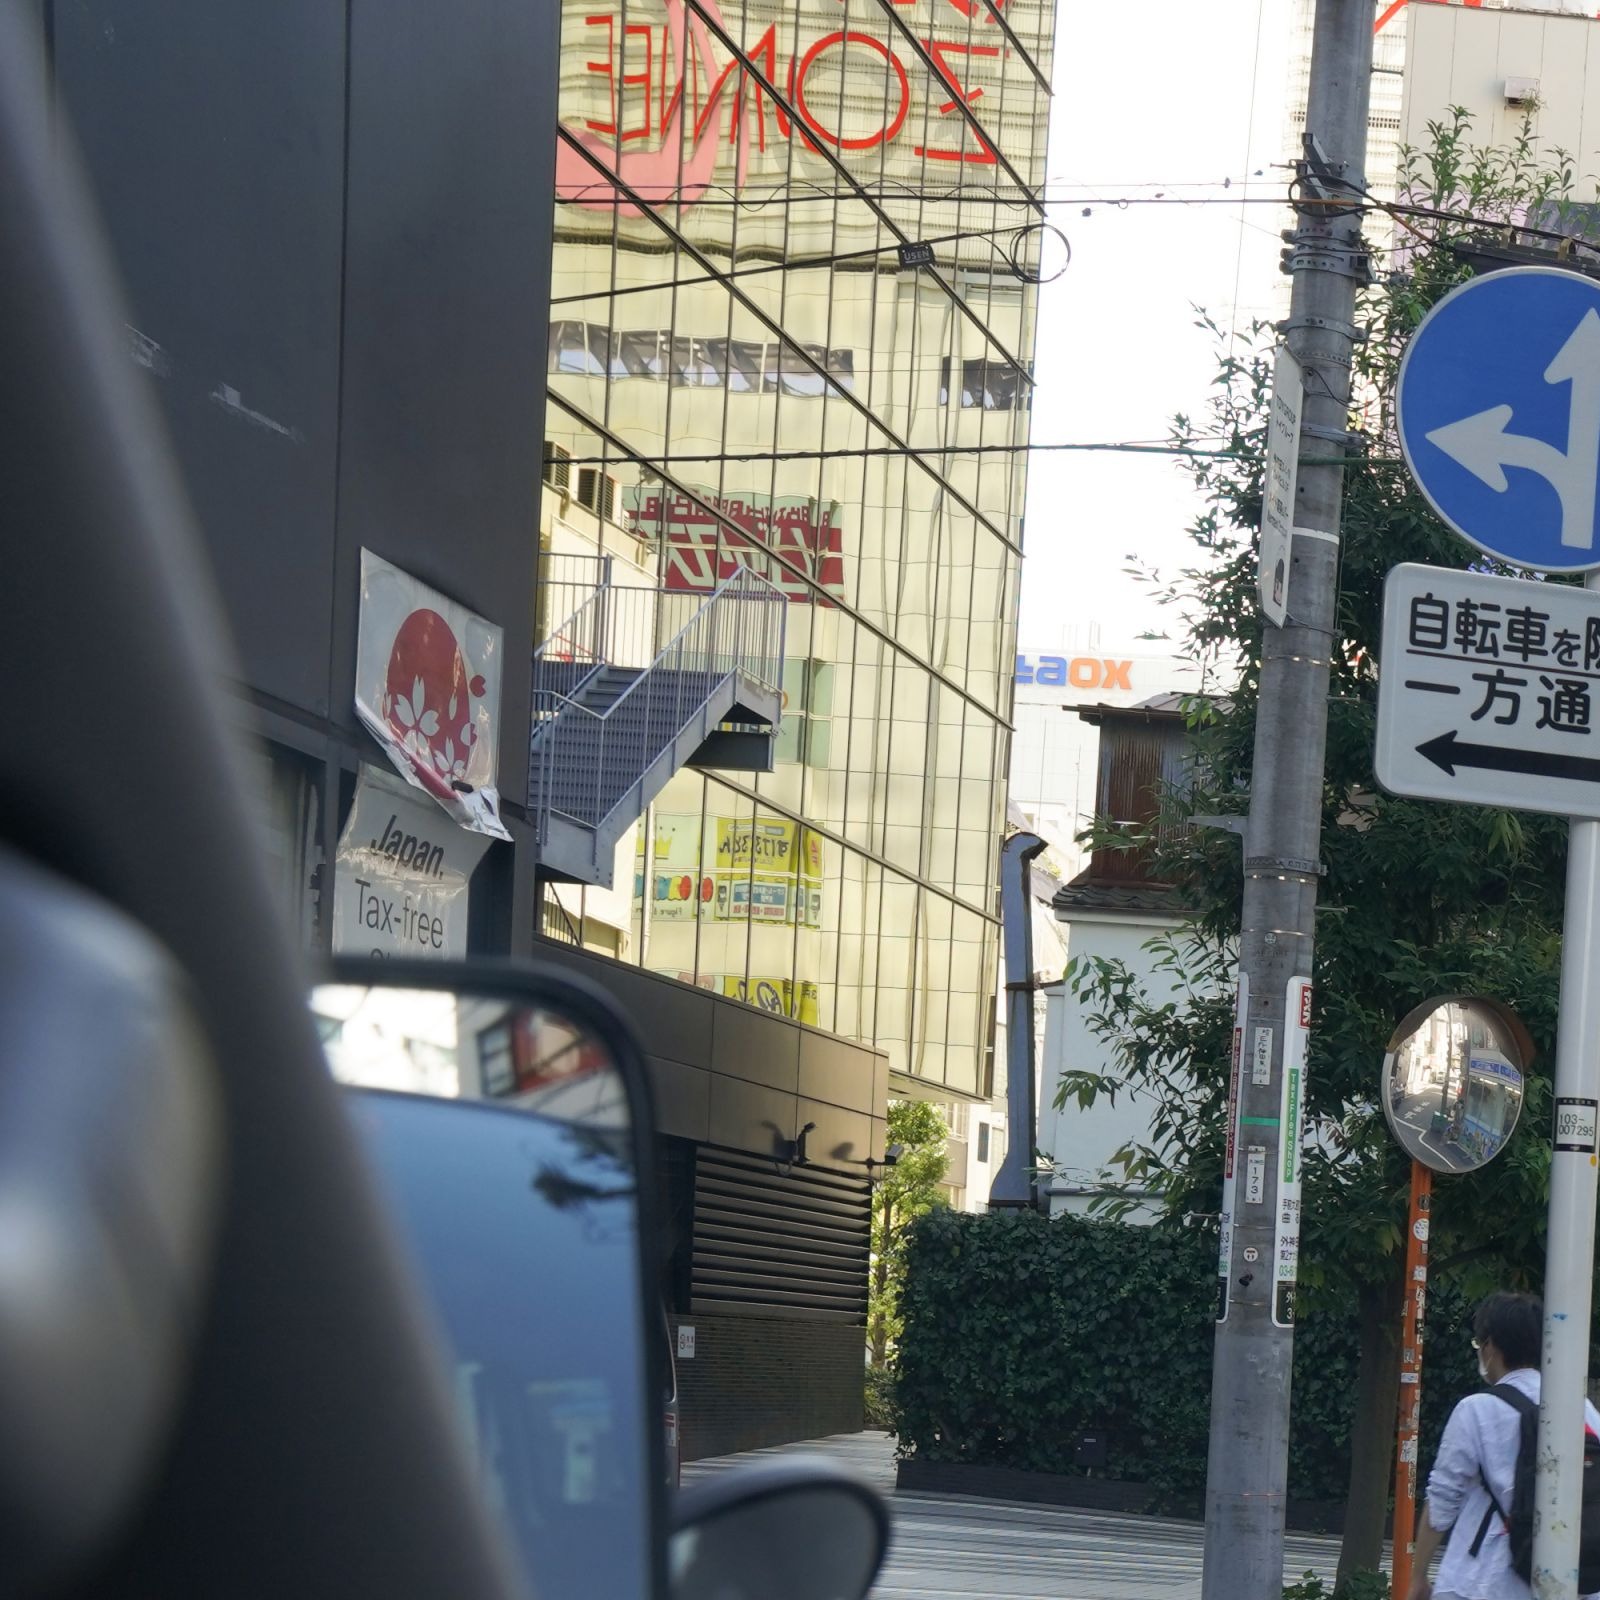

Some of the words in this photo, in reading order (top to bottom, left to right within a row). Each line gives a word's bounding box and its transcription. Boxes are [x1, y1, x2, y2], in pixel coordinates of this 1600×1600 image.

[903, 250, 930, 261] USEN
[369, 814, 445, 881] Japan.
[354, 878, 444, 949] Tax-free
[1559, 1113, 1585, 1124] 103-
[1558, 1124, 1594, 1137] 007295
